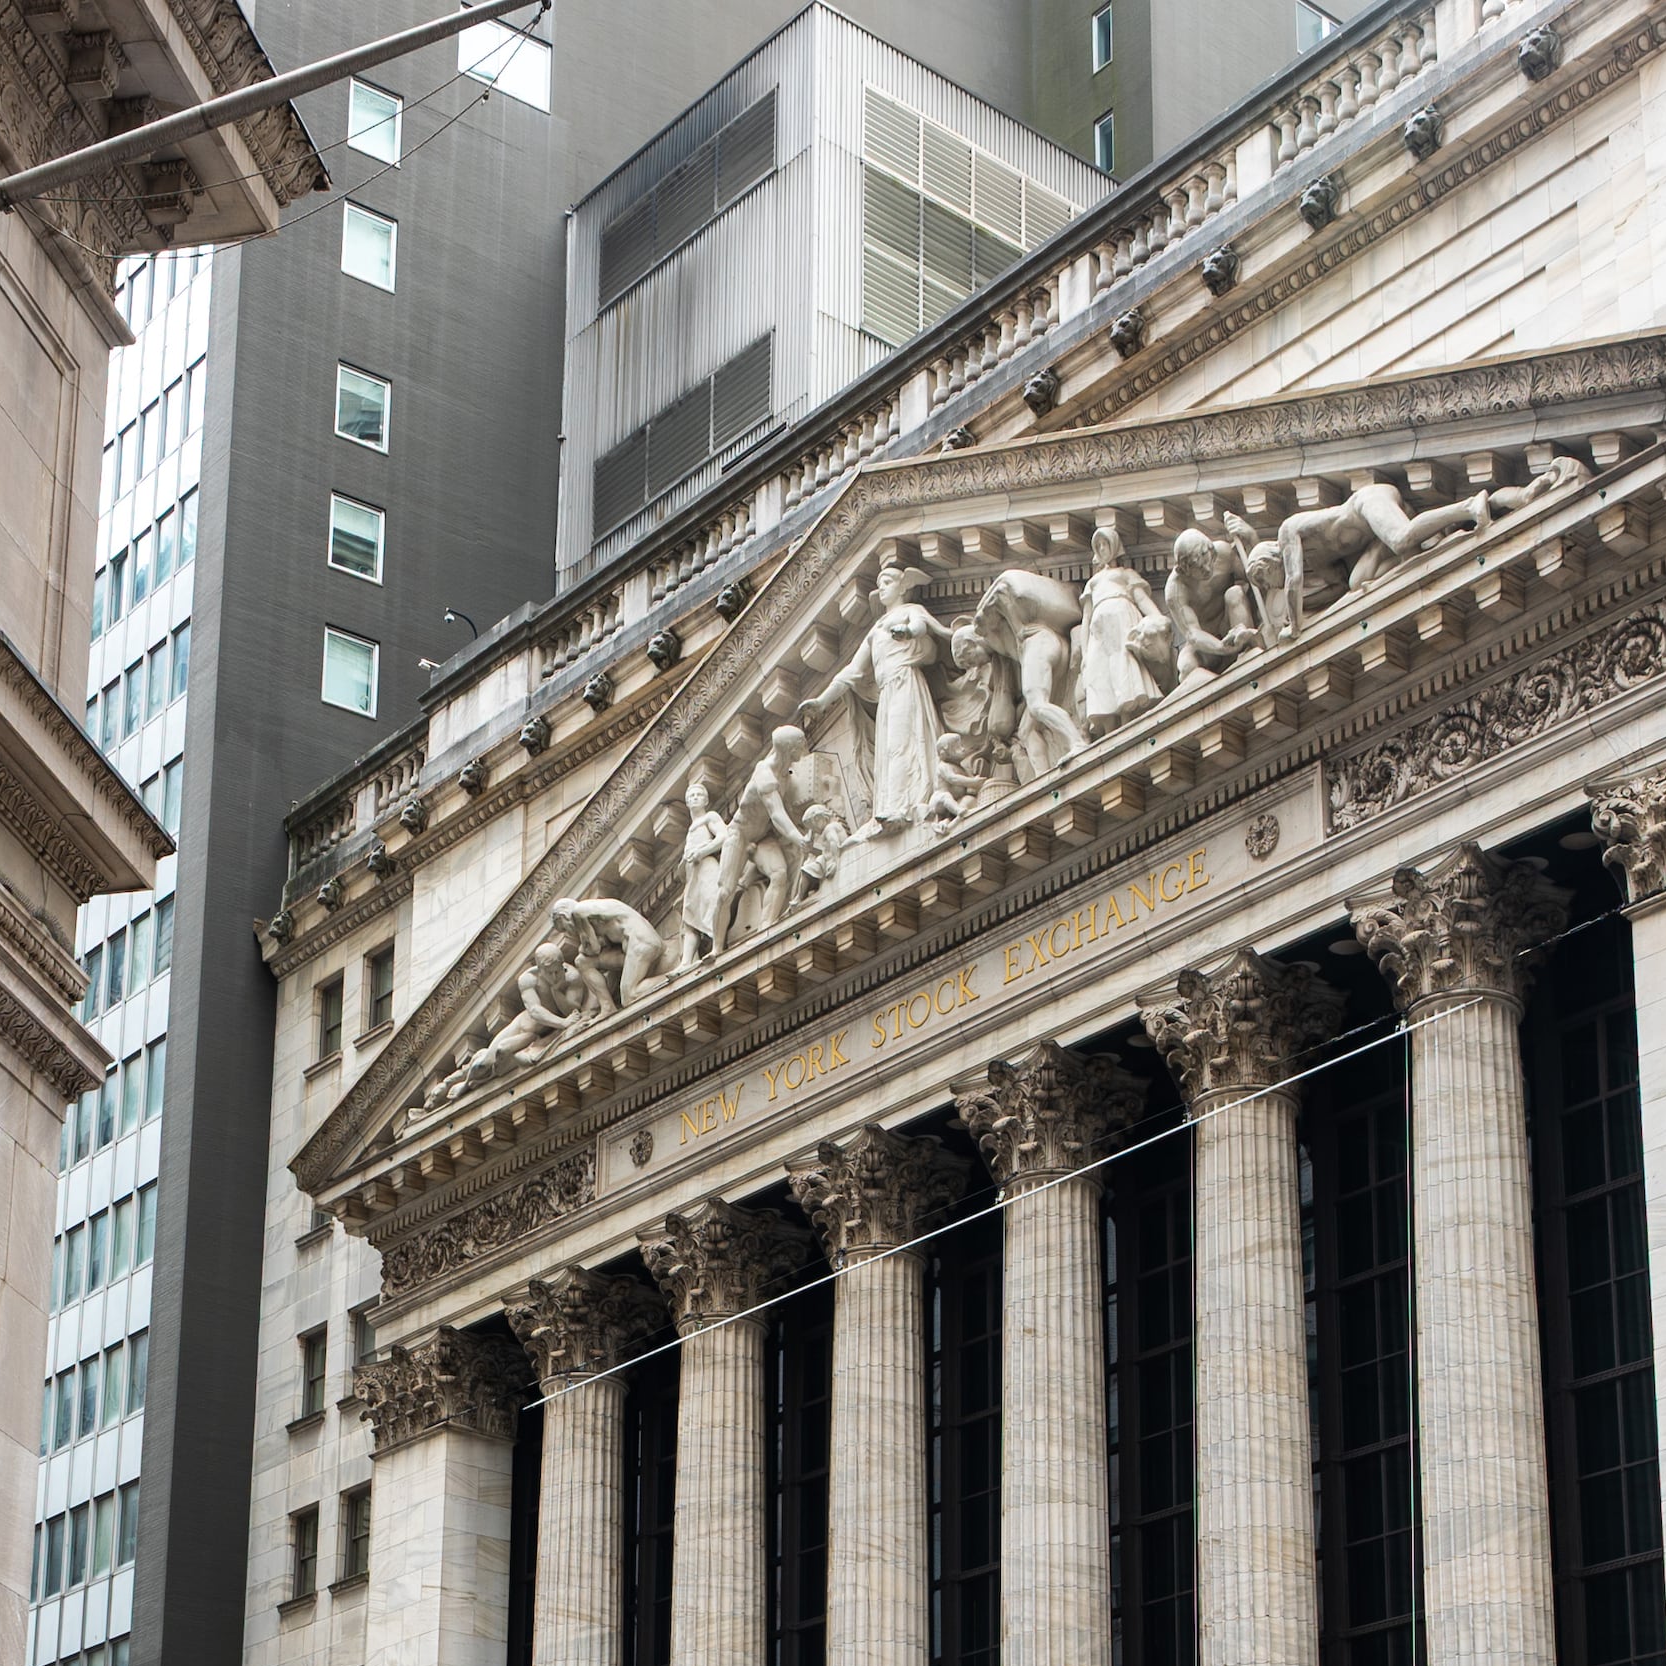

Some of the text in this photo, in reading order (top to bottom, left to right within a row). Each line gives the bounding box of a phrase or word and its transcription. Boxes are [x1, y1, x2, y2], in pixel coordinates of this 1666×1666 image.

[678, 847, 1212, 1147] NEW YORK STOCK EXCHANGE
